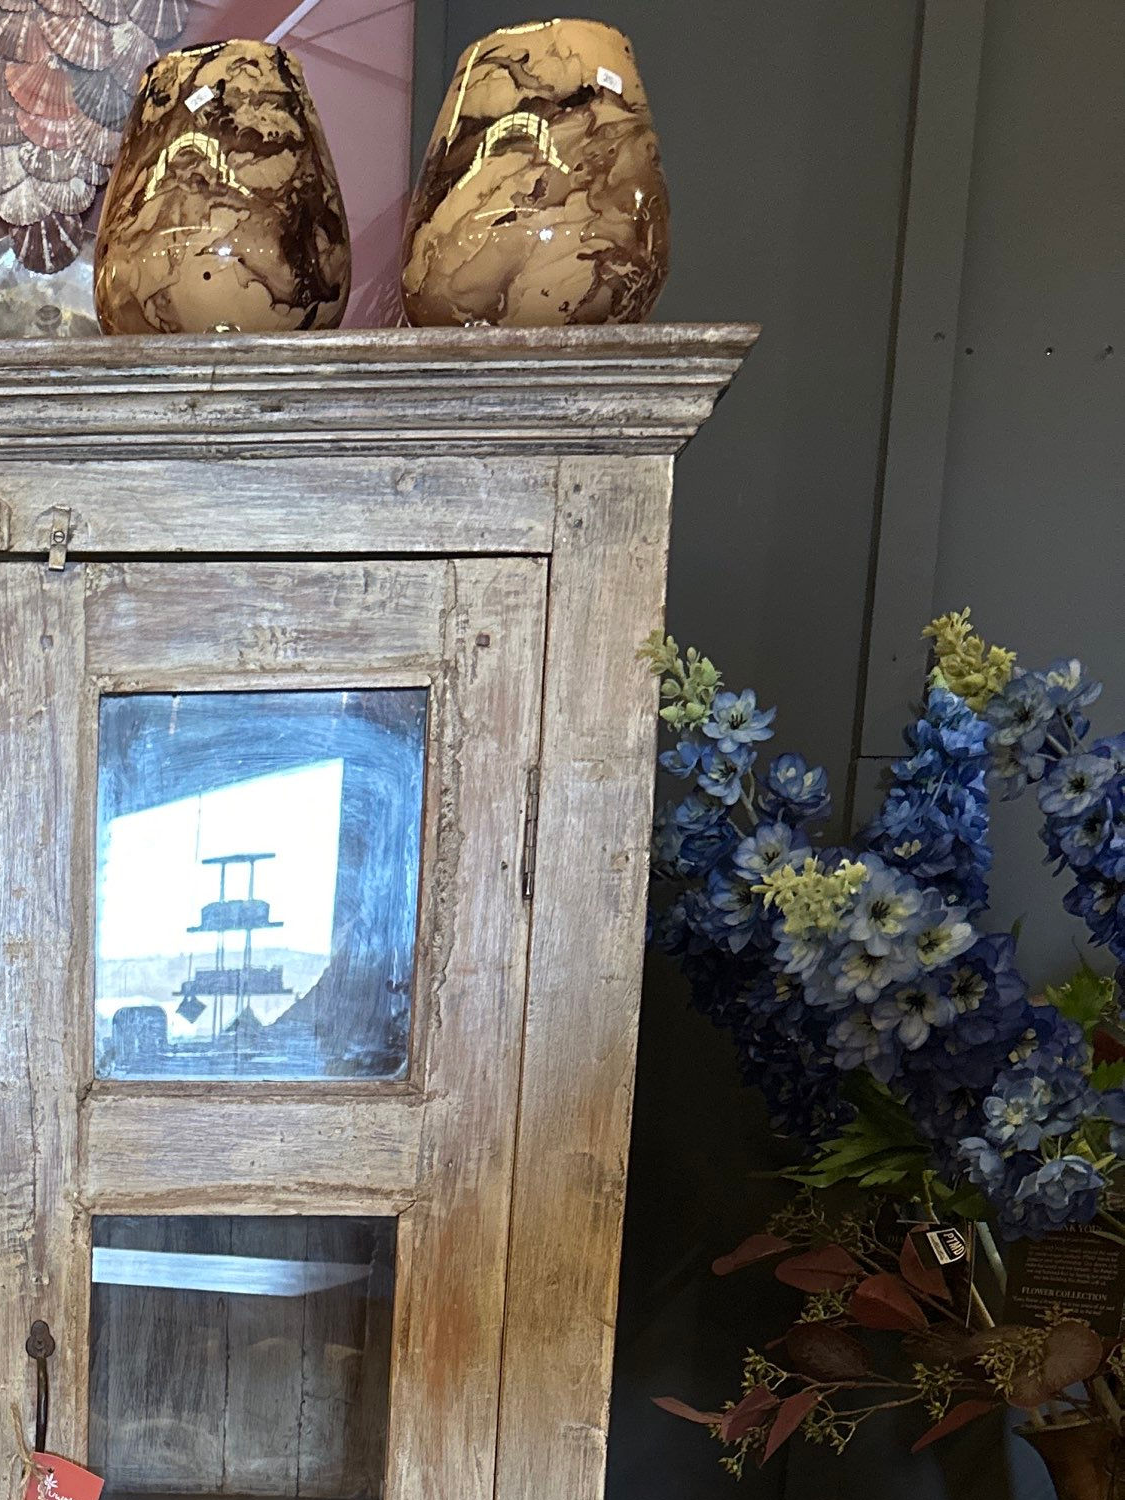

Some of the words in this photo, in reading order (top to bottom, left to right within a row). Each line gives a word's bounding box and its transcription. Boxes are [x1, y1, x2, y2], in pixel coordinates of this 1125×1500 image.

[942, 1232, 965, 1256] PTMD
[1021, 1285, 1054, 1297] FLOWER
[1055, 1289, 1108, 1301] COLLECTION
